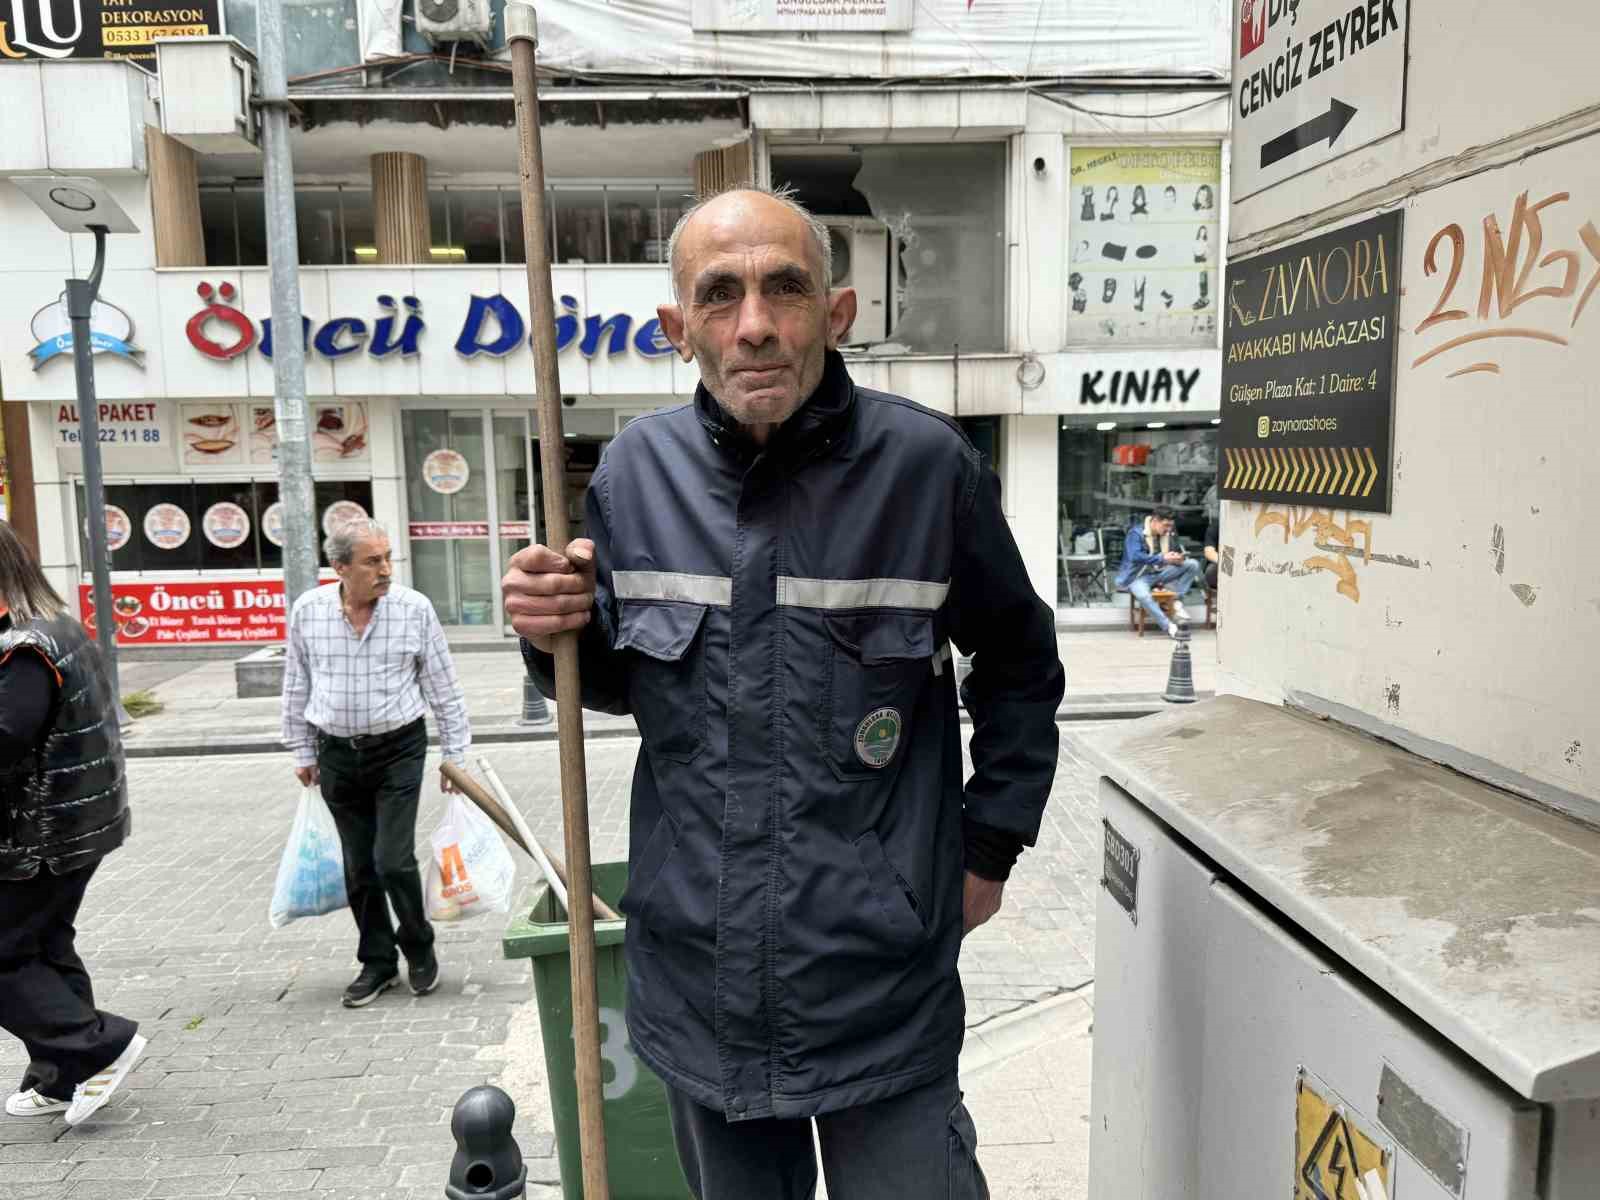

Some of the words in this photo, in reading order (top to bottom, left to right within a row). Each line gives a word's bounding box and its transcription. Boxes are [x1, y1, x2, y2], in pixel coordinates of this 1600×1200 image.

[101, 9, 204, 24] DEKORASYON
[106, 30, 141, 42] 0533
[1239, 37, 1304, 119] CENGİZ
[1307, 0, 1399, 79] ZEYREK
[1257, 233, 1389, 321] ZAYNORA
[1415, 223, 1469, 335] 2
[1227, 332, 1296, 363] AYAKKABI
[1300, 315, 1386, 352] MAĞAZASI
[1079, 367, 1200, 405] KINAY
[1230, 383, 1263, 405] Gülşen
[1264, 380, 1292, 400] Plaza
[1295, 377, 1316, 397] Kat:
[1319, 374, 1326, 394] 1
[1330, 373, 1364, 394] Daire:
[1367, 368, 1377, 391] 4
[58, 404, 80, 422] AL
[98, 403, 156, 422] PAKET
[1272, 416, 1337, 436] zaynorashoes
[97, 429, 116, 442] 22
[121, 429, 137, 442] 11
[143, 429, 160, 442] 88
[150, 586, 224, 611] Öncü
